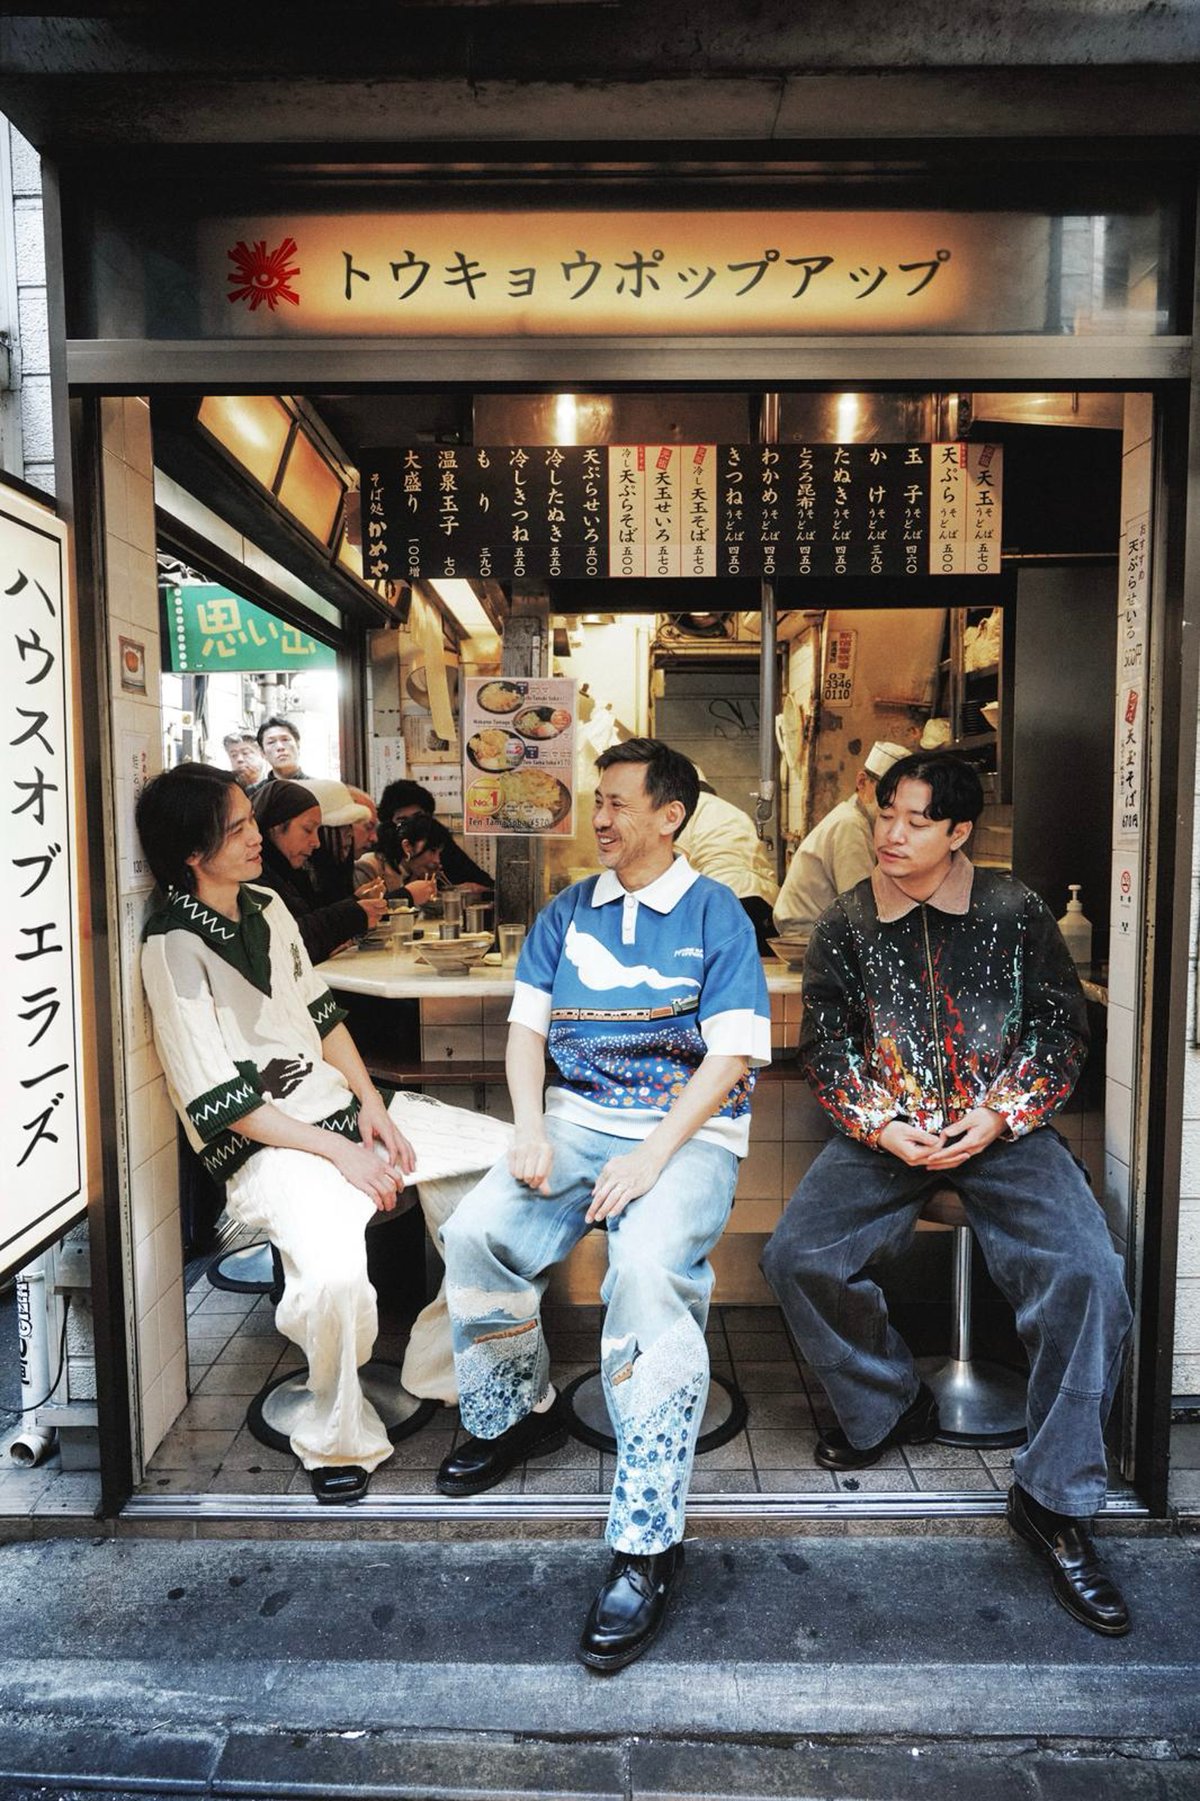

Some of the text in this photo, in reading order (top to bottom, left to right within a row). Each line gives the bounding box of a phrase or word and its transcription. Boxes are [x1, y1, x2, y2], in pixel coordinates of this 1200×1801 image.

[342, 247, 951, 301] トウキョウポップアップ
[403, 449, 422, 514] 大盛り
[725, 447, 743, 505] きつね
[762, 447, 779, 505] わかめ
[796, 447, 816, 510] とろろ昆布
[833, 447, 851, 505] たぬき
[869, 448, 887, 504] かけ
[903, 448, 923, 504] 玉子
[940, 446, 959, 503] 天ぷら
[975, 470, 994, 507] 天玉
[438, 450, 459, 576] 温泉玉子 七〇
[477, 449, 491, 577] もり 三九〇
[509, 448, 530, 576] 冷しきつね 五五〇
[545, 448, 566, 576] 冷したぬき 五五〇
[582, 448, 601, 576] 天ぷらせいろ 五〇〇
[618, 448, 638, 575] 冷し天ぷらそば 五〇〇
[654, 471, 672, 575] 天玉せいろ 五七〇
[689, 466, 709, 575] 冷し天玉そば 五七〇
[368, 521, 389, 577] かめや
[728, 546, 740, 574] 四五〇
[764, 546, 775, 574] 四五〇
[799, 546, 811, 574] 四五〇
[835, 545, 847, 574] 四五〇
[870, 545, 883, 574] 三九〇
[906, 545, 918, 574] 四六〇
[942, 544, 953, 572] 五〇〇
[977, 543, 989, 572] 五七〇
[825, 679, 851, 689] 3346
[825, 689, 850, 700] 0110
[828, 672, 846, 680] 03
[469, 817, 483, 826] Ten
[4, 567, 73, 1169] ハウスオブエラーズ
